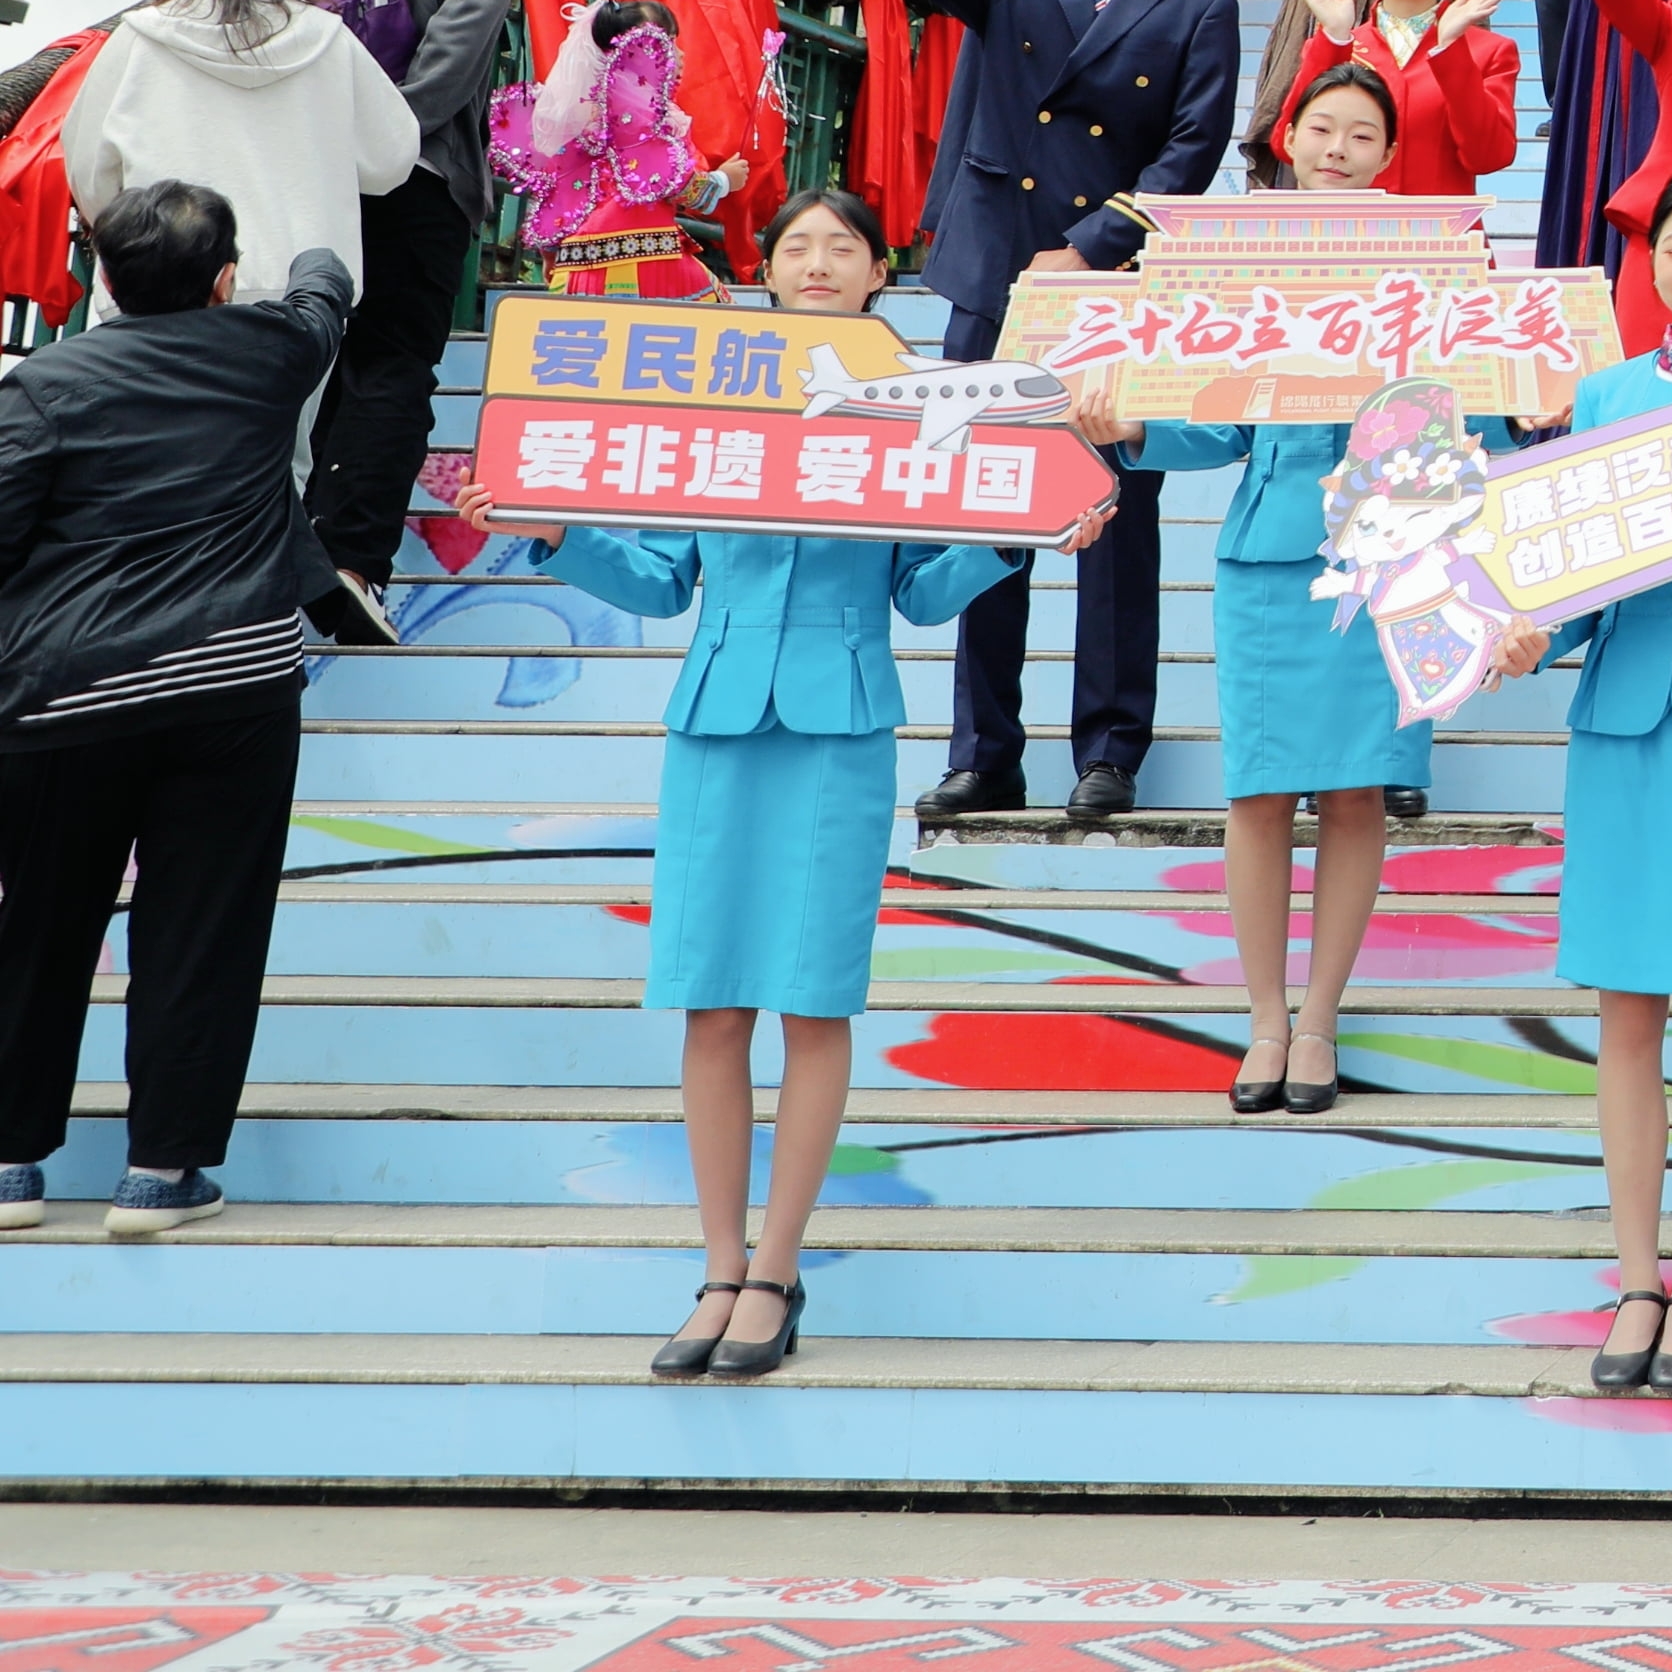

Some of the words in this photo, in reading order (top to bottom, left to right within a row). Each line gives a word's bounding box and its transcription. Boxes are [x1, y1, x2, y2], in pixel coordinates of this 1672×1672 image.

[531, 319, 787, 399] 爱民航
[517, 420, 766, 502] 爱非遗
[798, 435, 1037, 514] 爱中国
